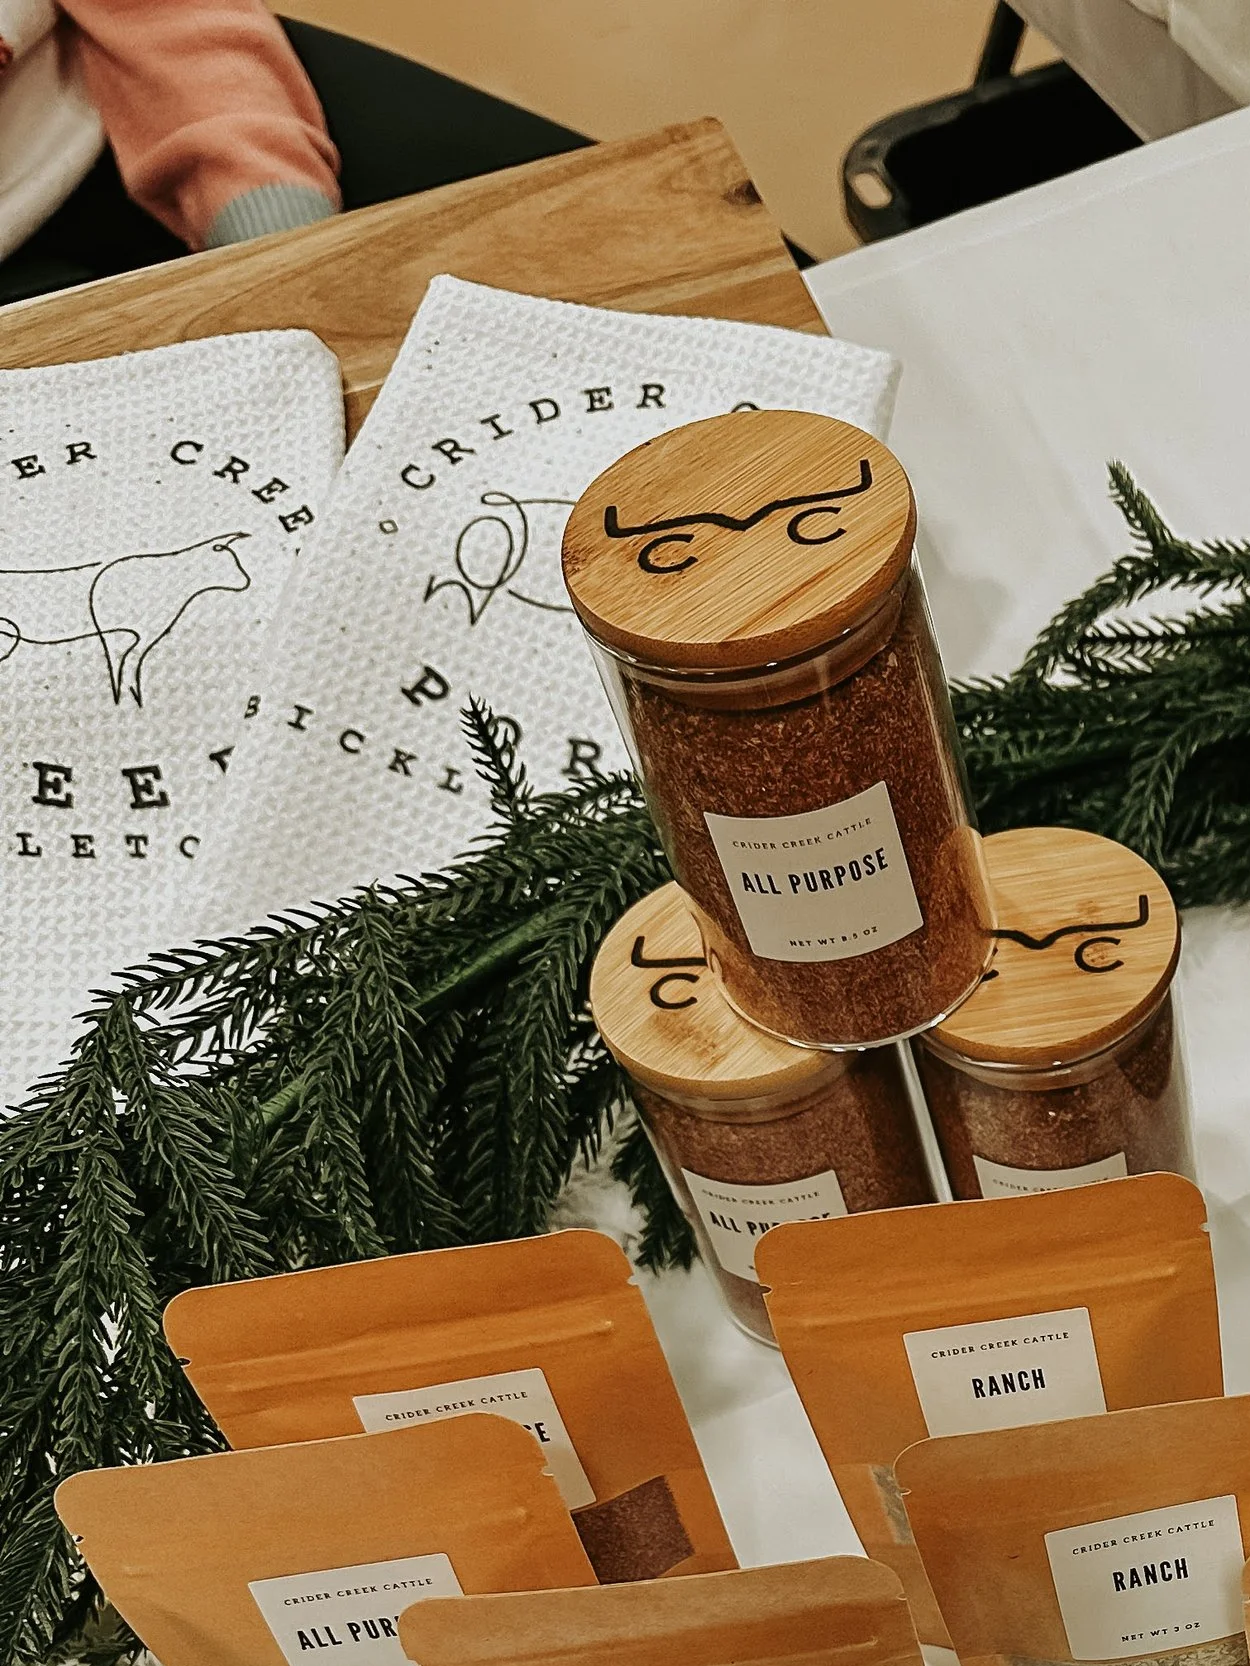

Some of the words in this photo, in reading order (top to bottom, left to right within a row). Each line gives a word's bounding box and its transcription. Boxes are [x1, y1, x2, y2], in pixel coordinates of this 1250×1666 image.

[400, 382, 666, 491] CRIDER
[170, 440, 314, 533] CREE
[741, 872, 782, 895] ALL
[788, 847, 889, 894] PURPOSE
[931, 1346, 975, 1358] CRIDER
[980, 1340, 1018, 1350] CREEK
[1023, 1332, 1069, 1344] CATTLE
[972, 1368, 1046, 1399] RANCH
[1113, 1558, 1189, 1592] RANCH
